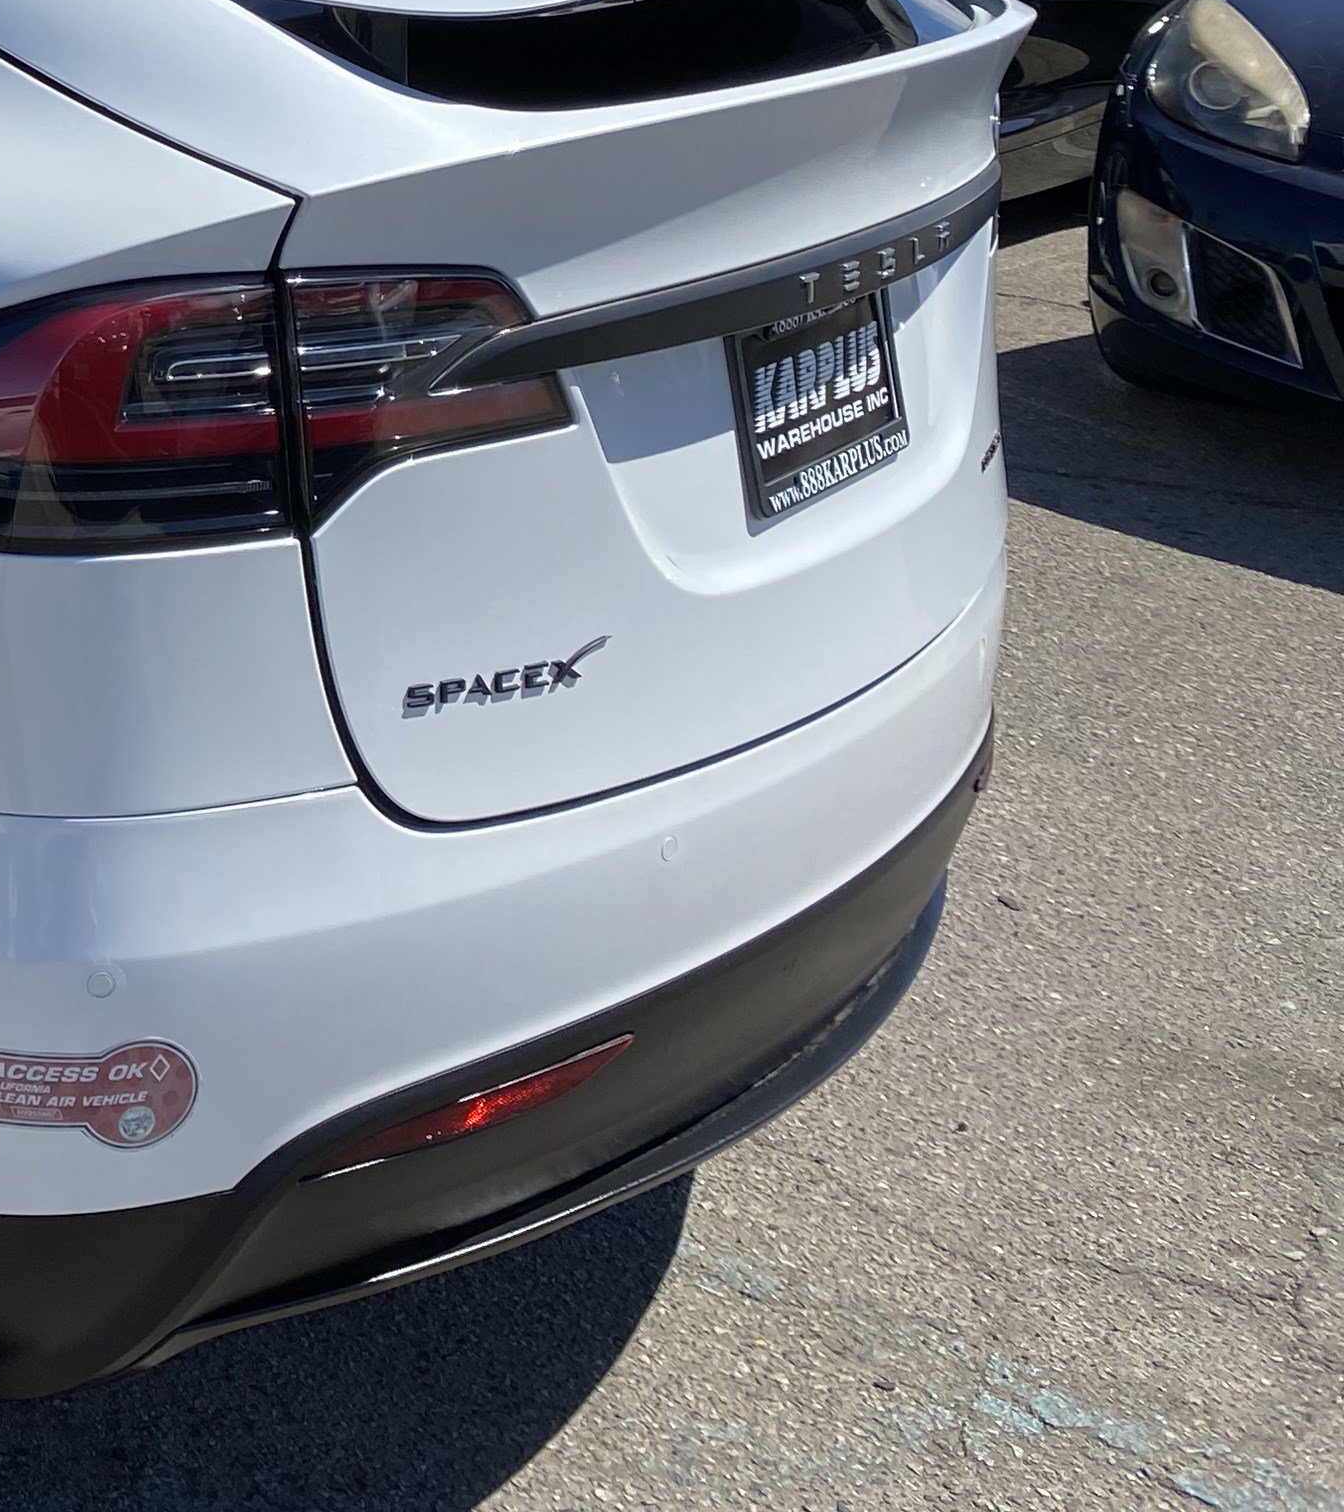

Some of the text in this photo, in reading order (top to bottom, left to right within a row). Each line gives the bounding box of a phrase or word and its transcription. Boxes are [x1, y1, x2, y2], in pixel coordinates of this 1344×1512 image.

[799, 221, 951, 304] TESLA
[754, 320, 881, 434] KARPLUS
[756, 387, 889, 460] WAREHOUSE INC
[406, 635, 613, 709] SPACEX
[45, 1095, 76, 1107] AIR
[82, 1091, 148, 1107] VEHICLE
[108, 1062, 149, 1082] OK
